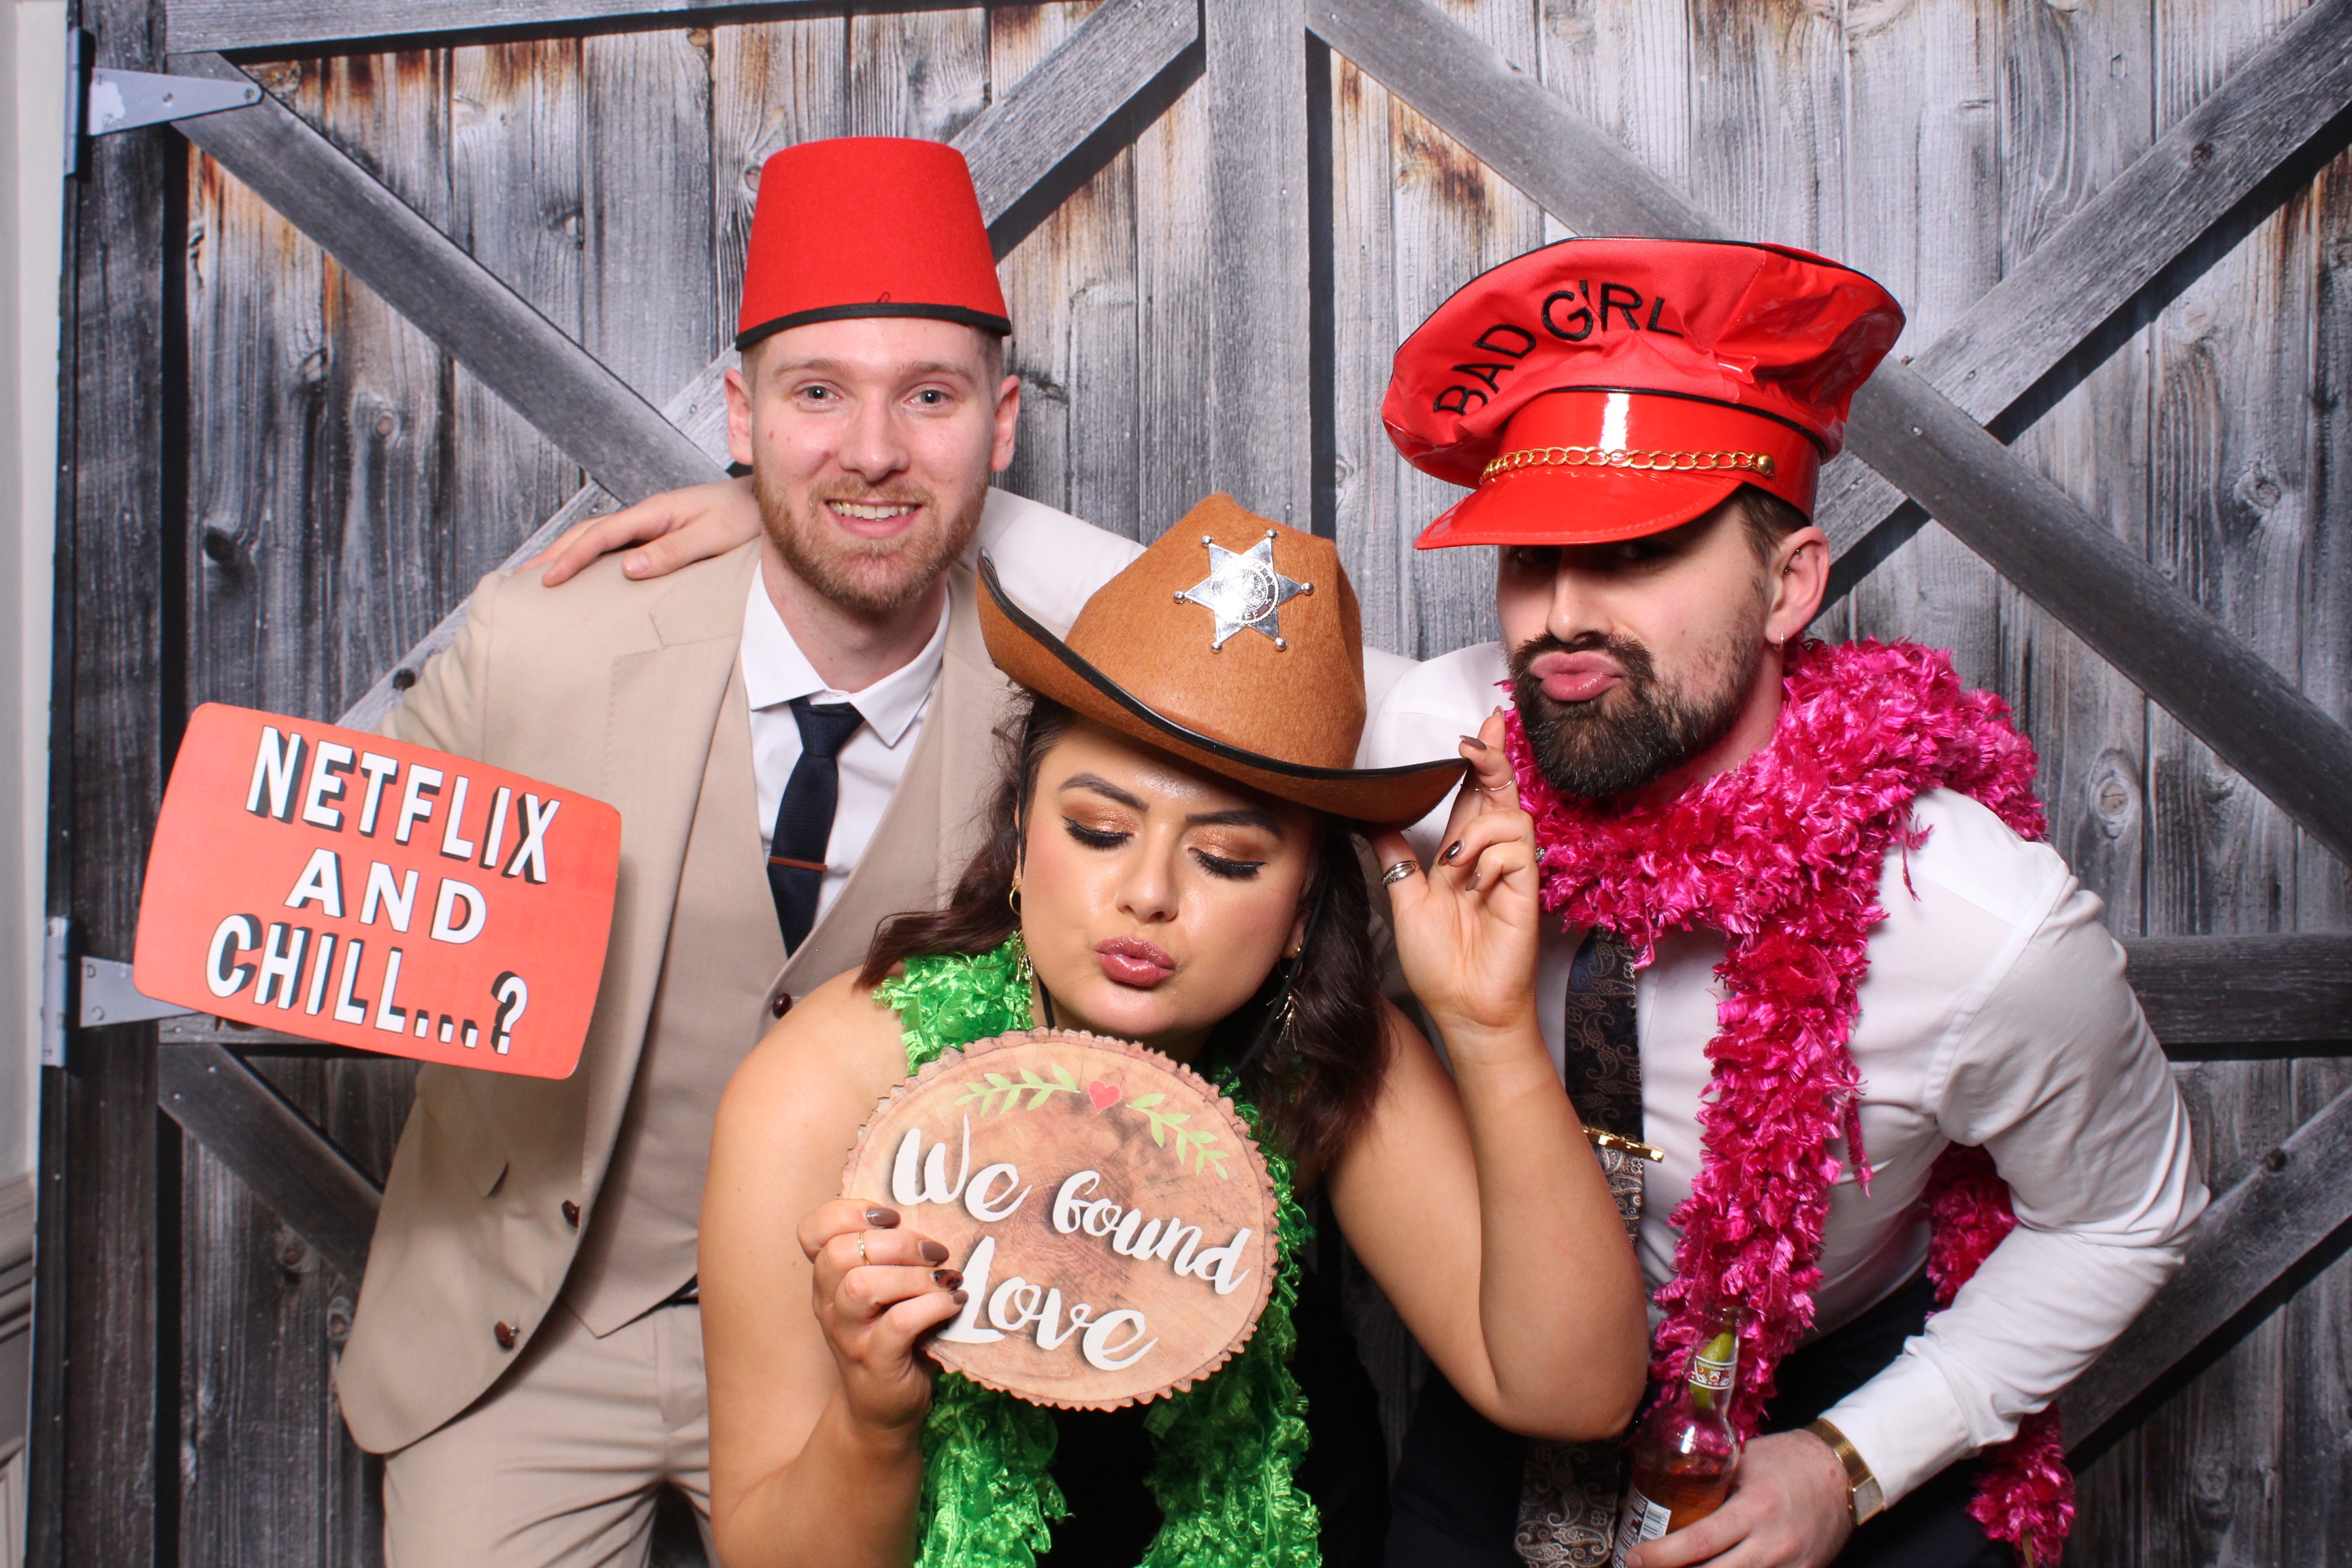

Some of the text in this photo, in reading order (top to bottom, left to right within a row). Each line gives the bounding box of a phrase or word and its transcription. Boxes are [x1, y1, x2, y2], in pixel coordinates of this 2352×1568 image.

[1433, 323, 1537, 417] BAD
[245, 725, 561, 884] NETFLIX
[283, 847, 487, 945] AND
[206, 913, 528, 1056] CHILL...?
[892, 1113, 1252, 1295] We found
[936, 1236, 1158, 1371] Love
